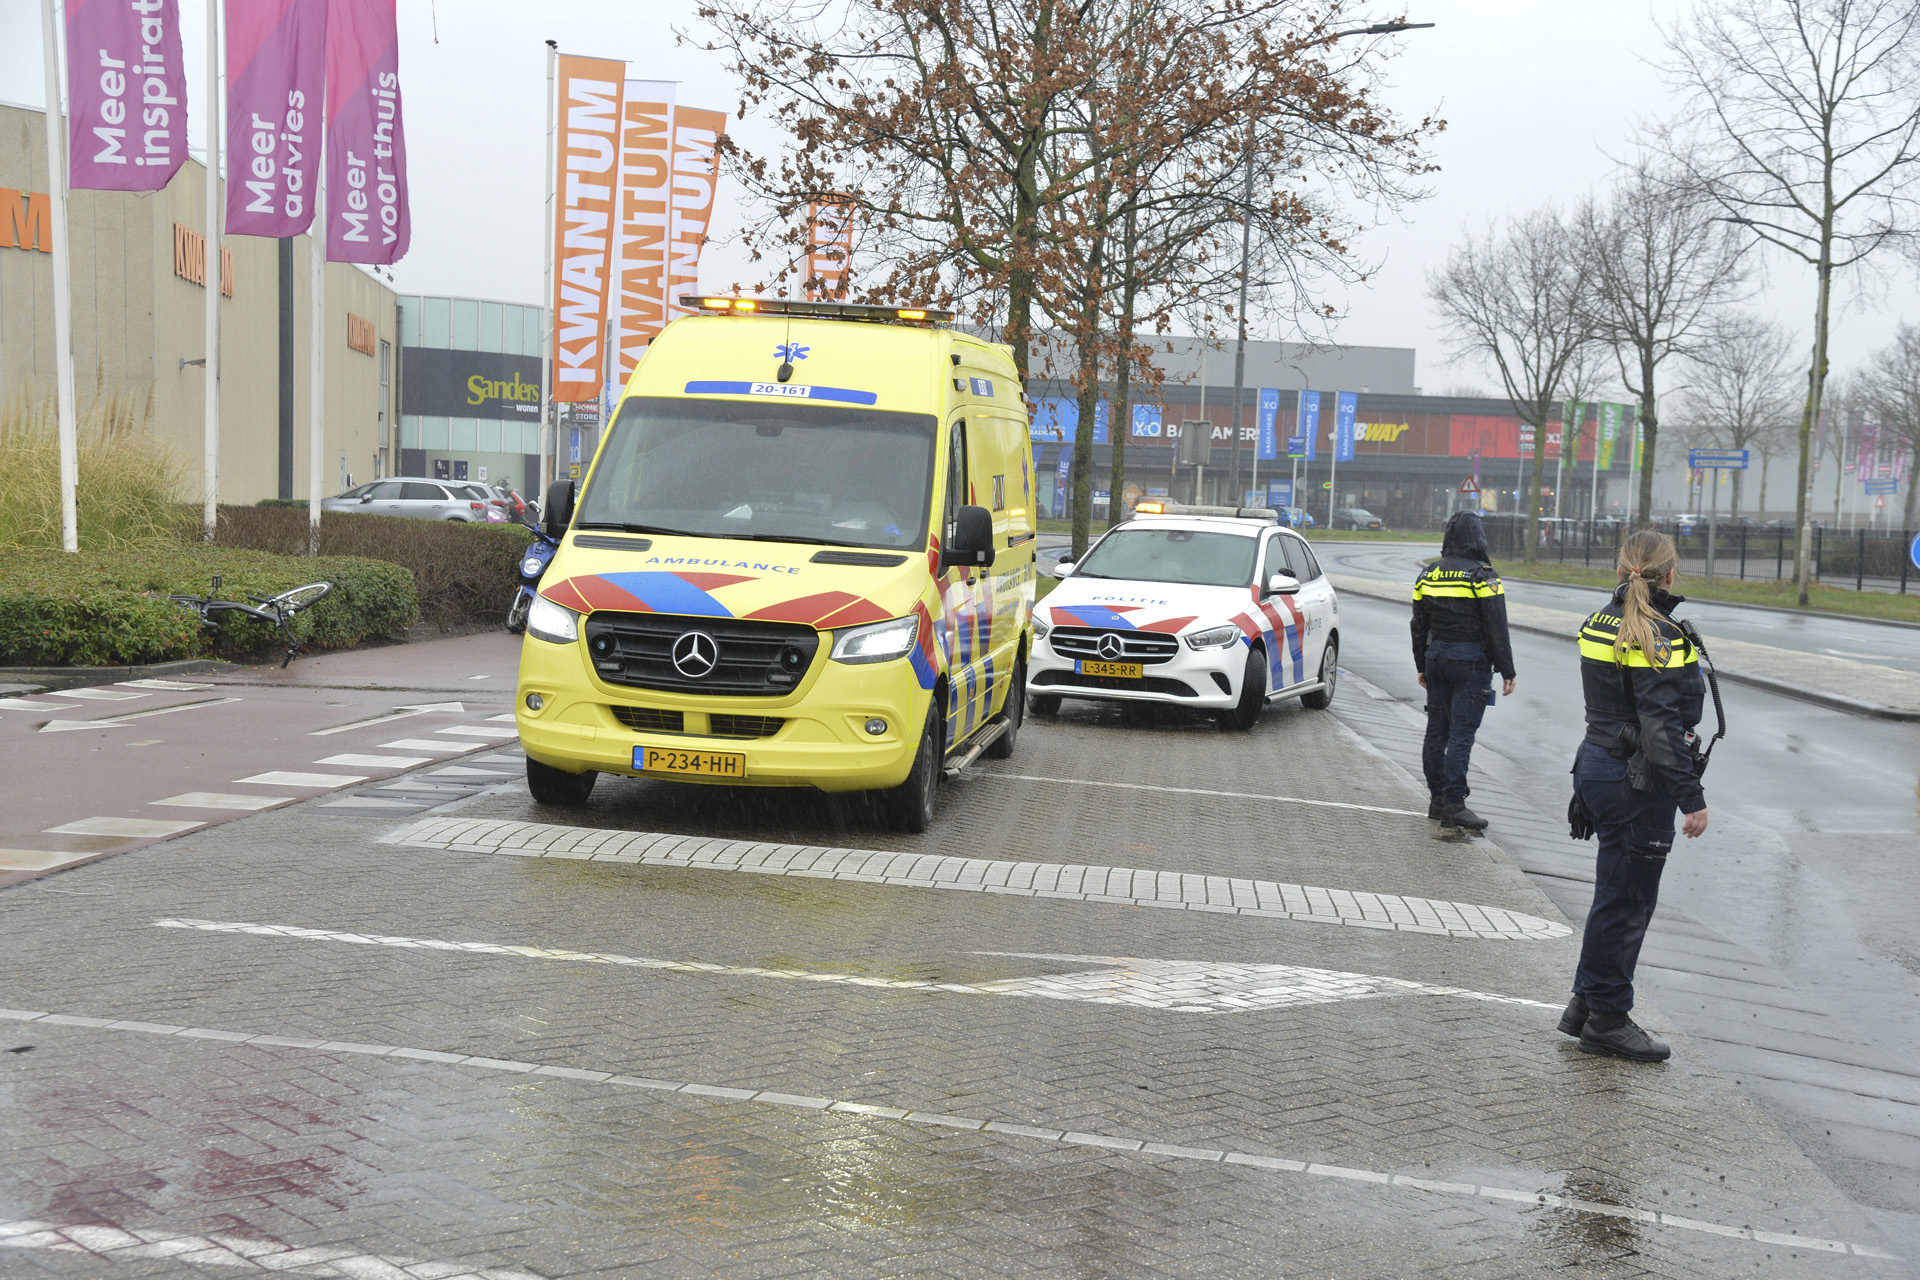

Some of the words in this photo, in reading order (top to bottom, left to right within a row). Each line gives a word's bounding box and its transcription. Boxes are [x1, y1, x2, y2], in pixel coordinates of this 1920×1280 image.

[93, 49, 126, 164] Meer
[132, 0, 177, 166] inspirat
[372, 71, 397, 159] thuis
[246, 113, 276, 214] Meer
[281, 90, 305, 218] advies
[343, 150, 370, 243] Meer
[374, 166, 398, 245] voor
[559, 77, 618, 383] KWANTUM
[467, 372, 539, 405] Sanders
[516, 404, 539, 413] wonen
[755, 384, 806, 396] 20-161
[575, 413, 598, 421] STORE
[644, 557, 800, 575] AMBULANCE
[1092, 596, 1168, 605] POLITIE
[1084, 662, 1136, 676] L-345-RR
[649, 751, 736, 773] P-234-HH
